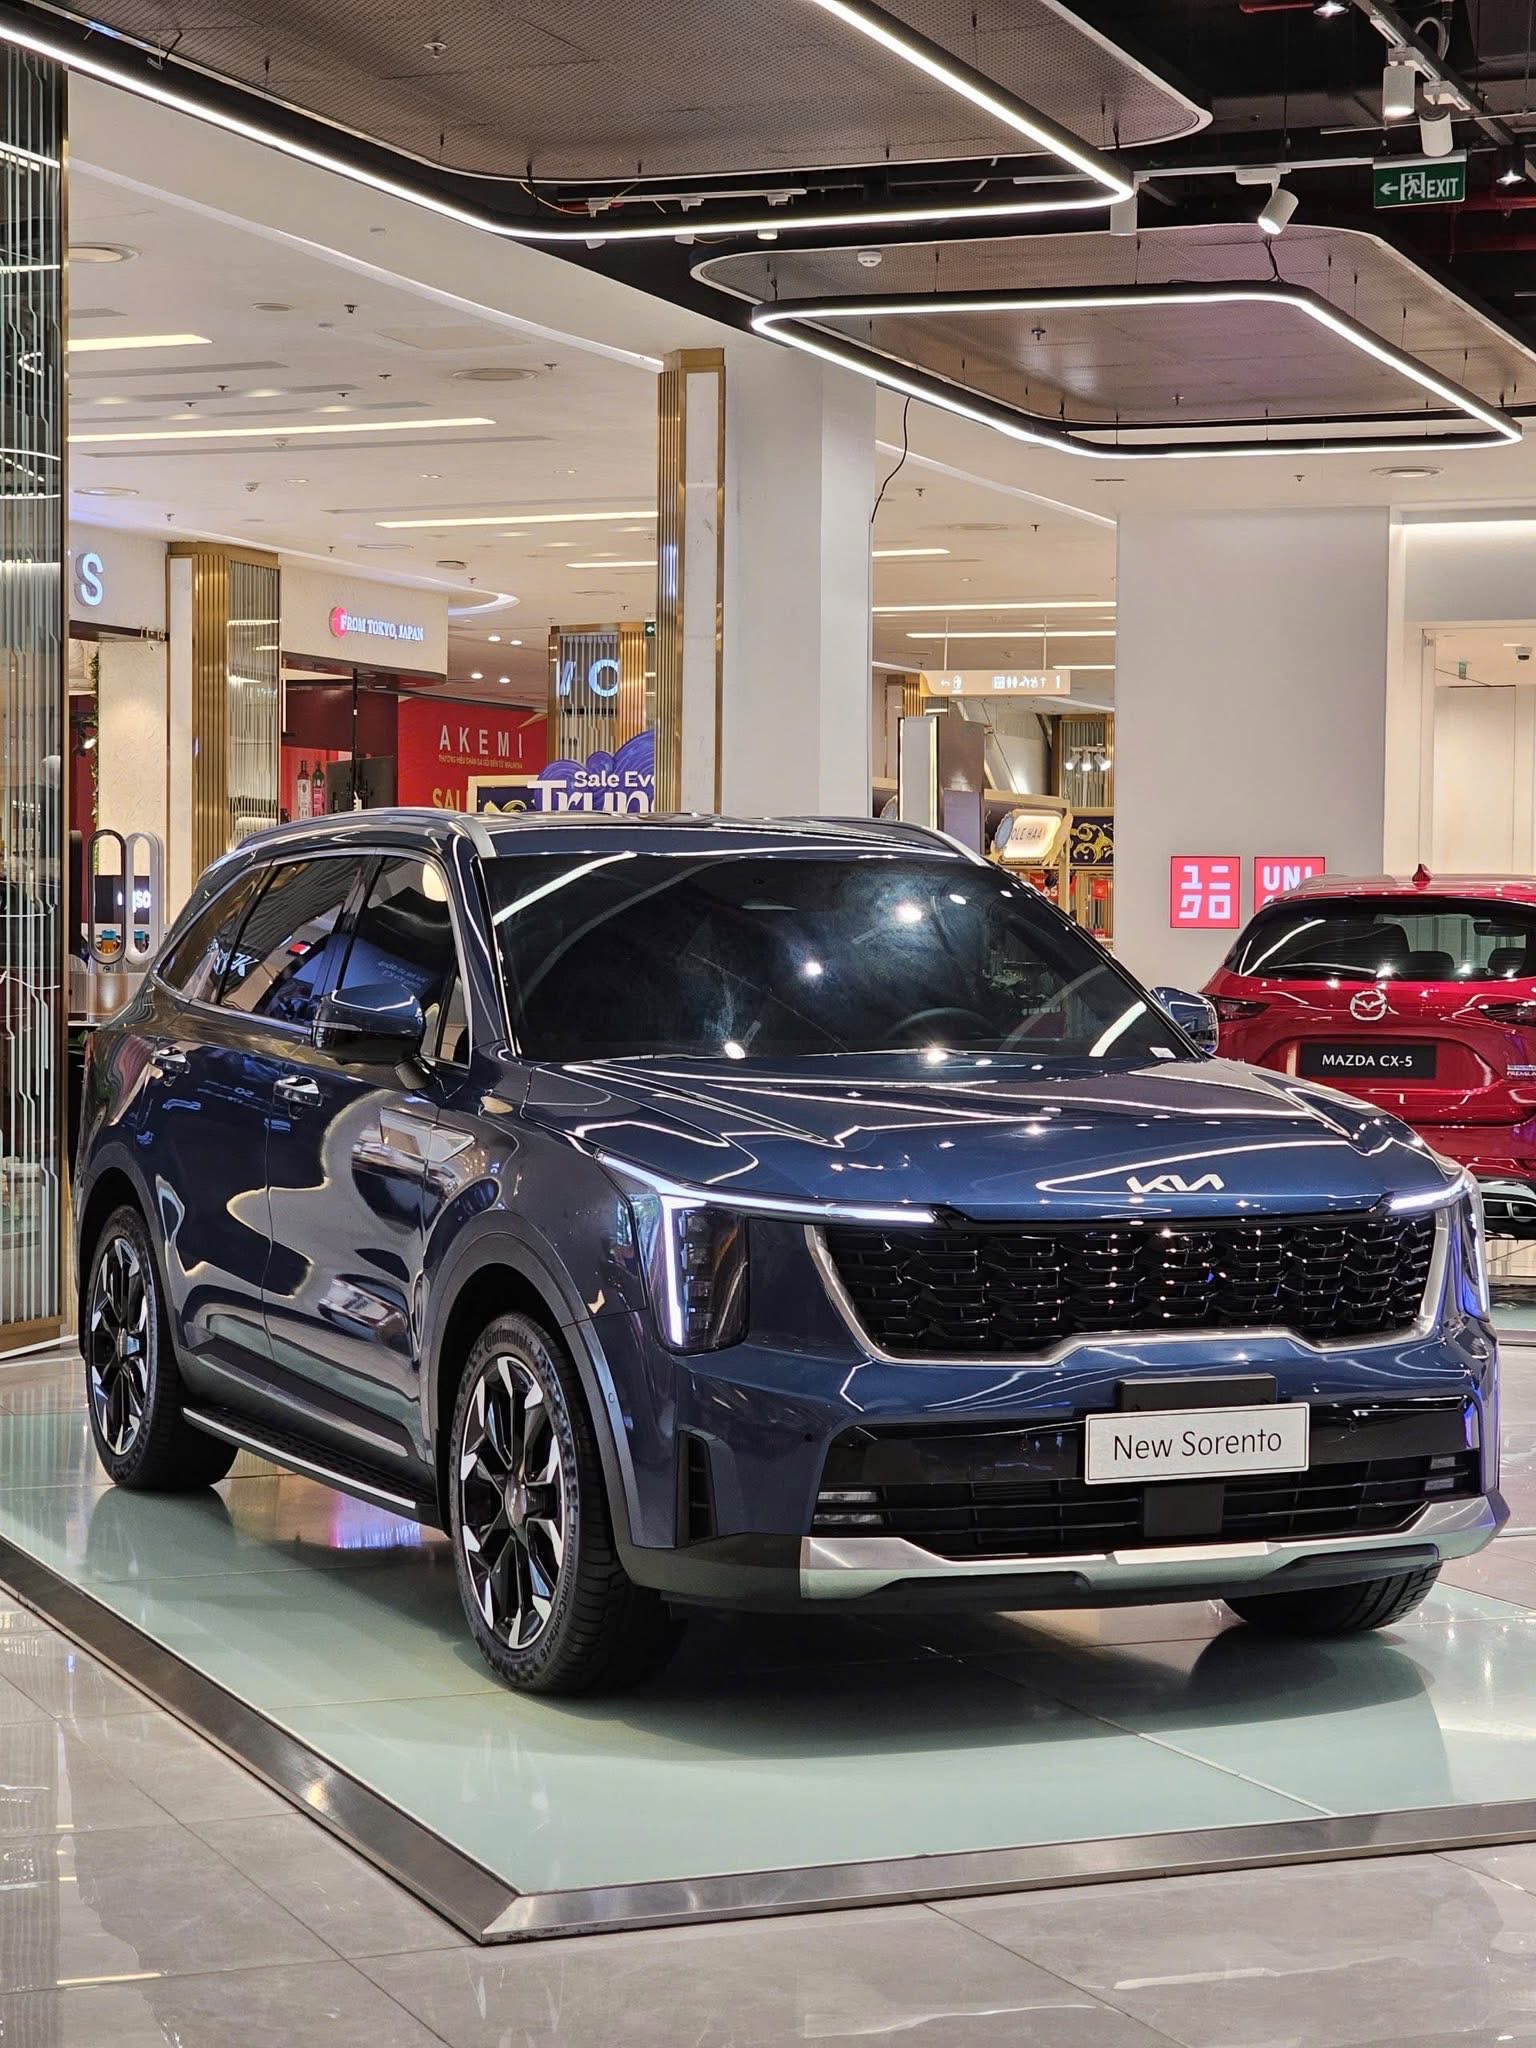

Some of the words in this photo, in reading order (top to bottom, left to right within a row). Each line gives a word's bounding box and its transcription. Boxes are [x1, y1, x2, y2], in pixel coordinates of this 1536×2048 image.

[1426, 177, 1459, 199] EXIT
[340, 614, 366, 633] FROM
[366, 619, 398, 640] TOKYO,
[398, 625, 424, 641] JAPAN
[439, 725, 523, 759] AKEMI
[573, 770, 620, 788] Sale
[1180, 865, 1232, 890] ユニ
[1178, 895, 1232, 919] クロ
[1321, 1053, 1375, 1067] MAZDA
[1379, 1054, 1413, 1068] CX-5
[1114, 1434, 1174, 1461] New
[1181, 1428, 1283, 1457] Sorento
